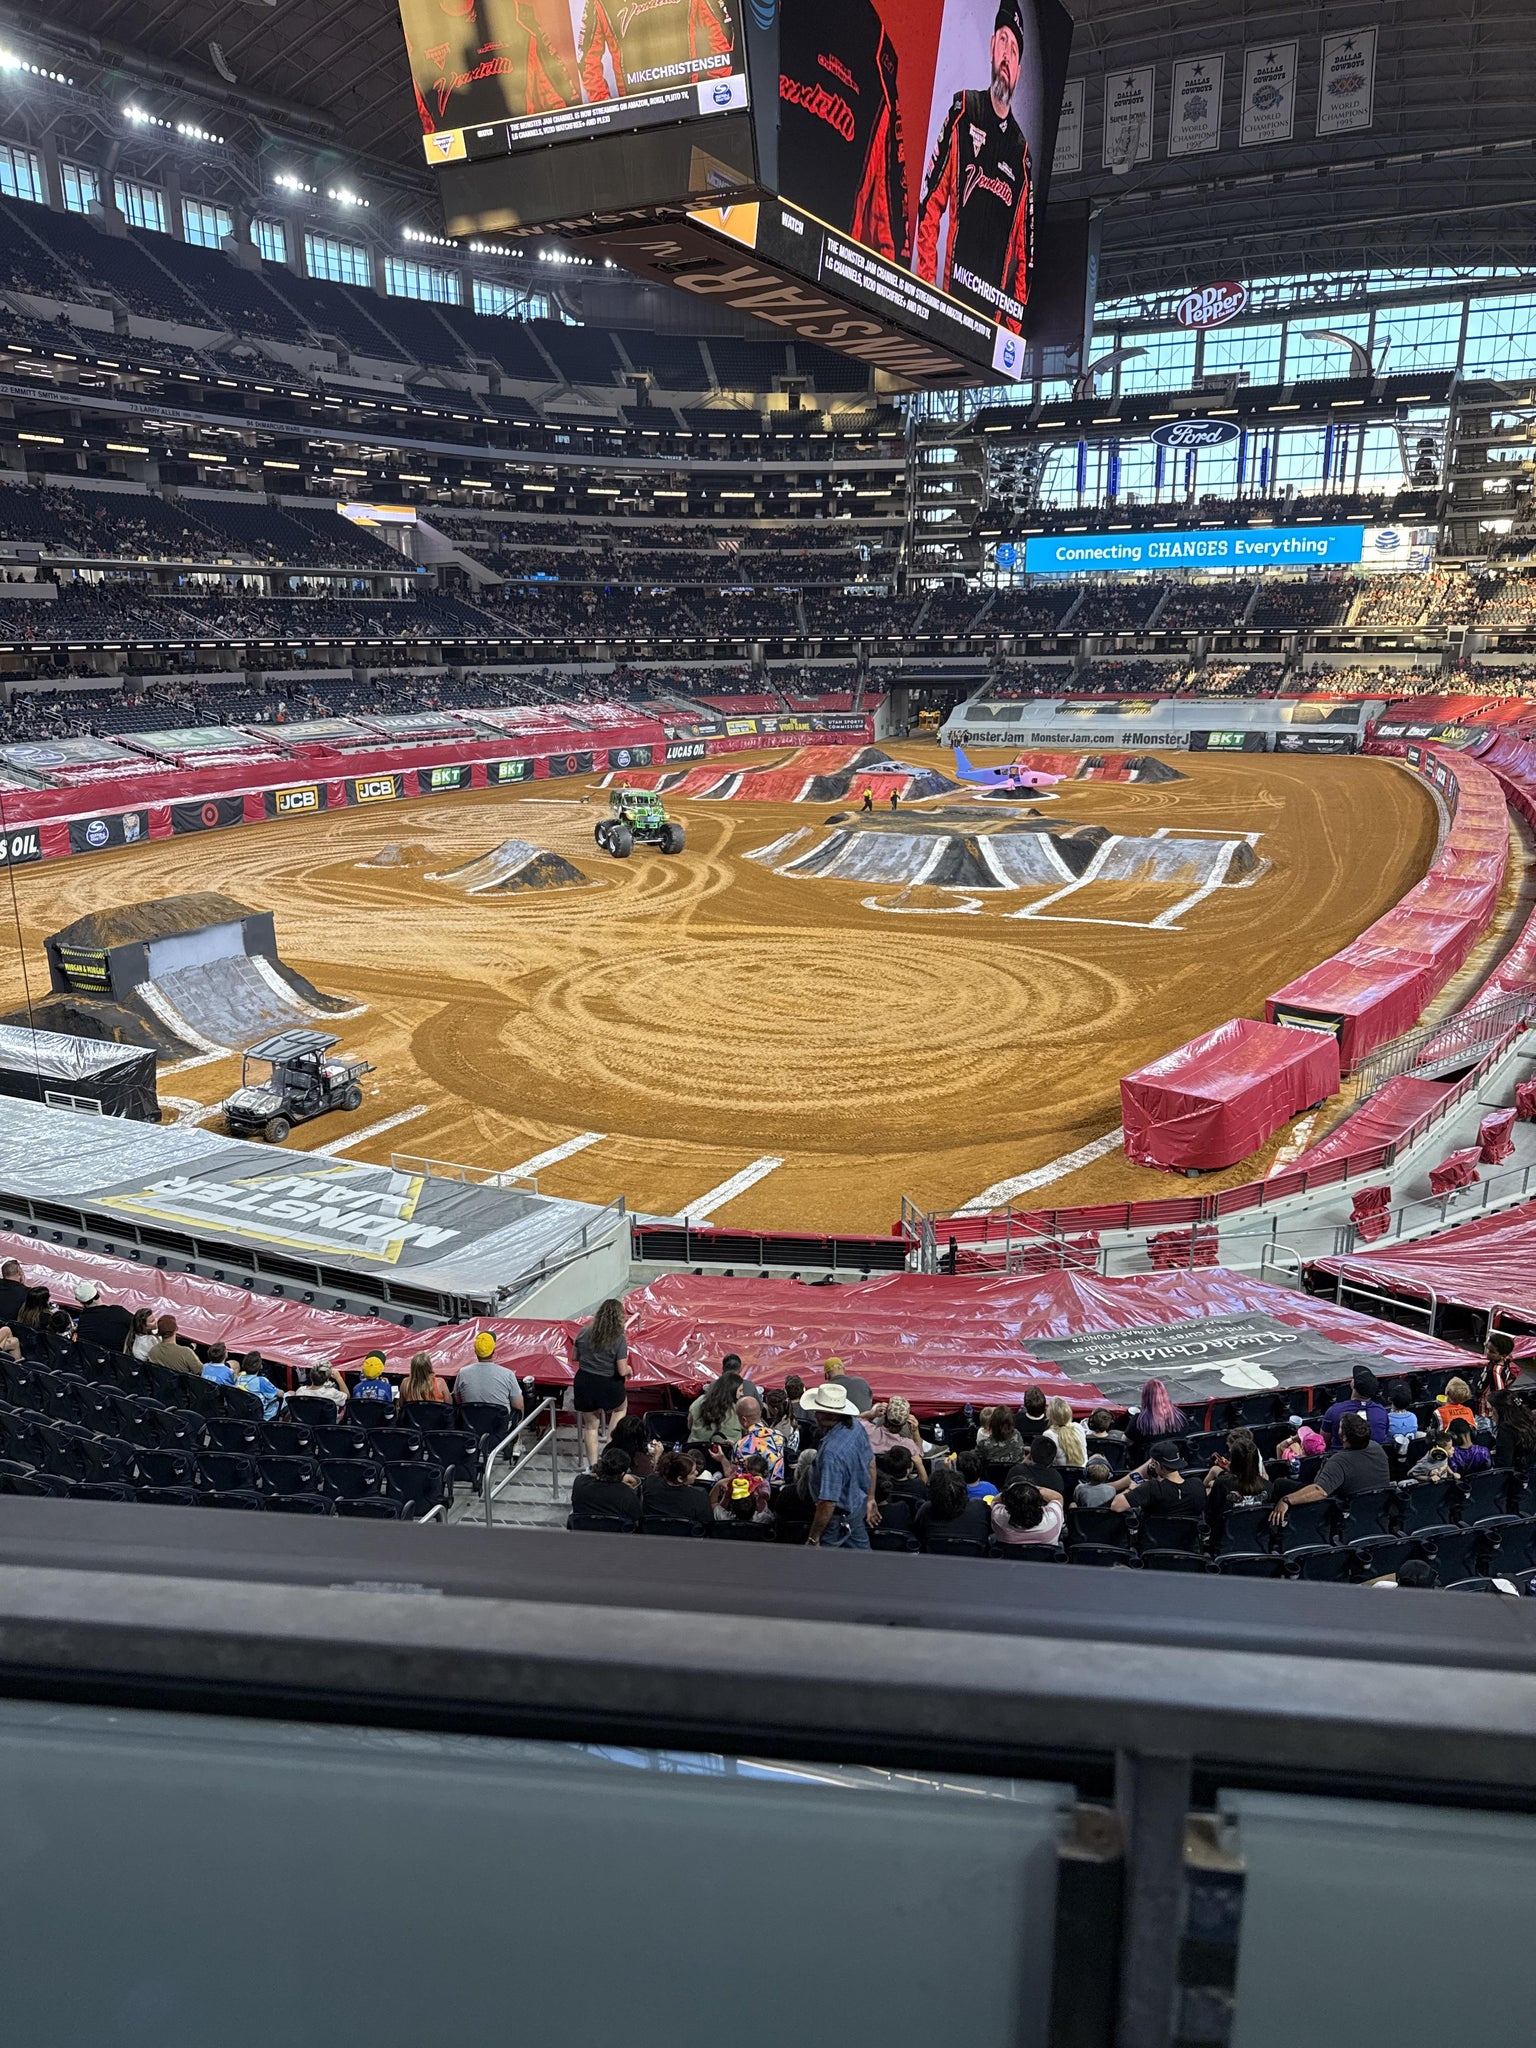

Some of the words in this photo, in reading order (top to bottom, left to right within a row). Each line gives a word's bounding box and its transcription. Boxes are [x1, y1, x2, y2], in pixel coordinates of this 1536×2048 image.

[1334, 52, 1362, 63] DALLAS
[1257, 65, 1283, 76] DALLAS
[1331, 59, 1365, 72] COWBOYS
[1185, 77, 1210, 88] DALLAS
[1253, 72, 1286, 84] COWBOYS
[1117, 89, 1142, 100] DALLAS
[1181, 84, 1213, 96] COWBOYS
[1331, 101, 1360, 111] WORLD
[1253, 112, 1281, 123] WORLD
[1321, 108, 1368, 122] CHAMPIONS
[1244, 120, 1289, 133] CHAMPIONS
[781, 211, 804, 235] WATCH
[825, 255, 834, 270] LG
[827, 237, 839, 253] THE
[839, 243, 865, 269] MONSTER
[864, 258, 877, 275] JAM
[904, 279, 916, 297] NOW
[1202, 287, 1227, 308] Dr
[1178, 292, 1242, 326] Pepper
[673, 265, 965, 376] WINSTAR
[0, 385, 9, 394] 22
[10, 387, 36, 397] EMMITT
[37, 390, 59, 400] SMITH
[129, 404, 139, 412] 73
[140, 405, 160, 414] LARRY
[160, 408, 181, 417] ALLEN
[1168, 424, 1223, 445] Ford
[1055, 544, 1142, 562] Connecting
[1148, 540, 1228, 558] CHANGES
[1031, 732, 1114, 744] MonsterJam.com
[1122, 732, 1189, 745] #MonsterJ
[1208, 733, 1245, 744] BKT
[666, 744, 693, 759] LUCAS
[693, 743, 705, 757] OIL
[432, 769, 460, 784] BKT
[499, 763, 524, 777] BKT
[359, 780, 392, 798] JCB
[280, 791, 316, 810] JCB
[11, 834, 38, 857] OIL
[144, 1176, 460, 1248] MONSTER
